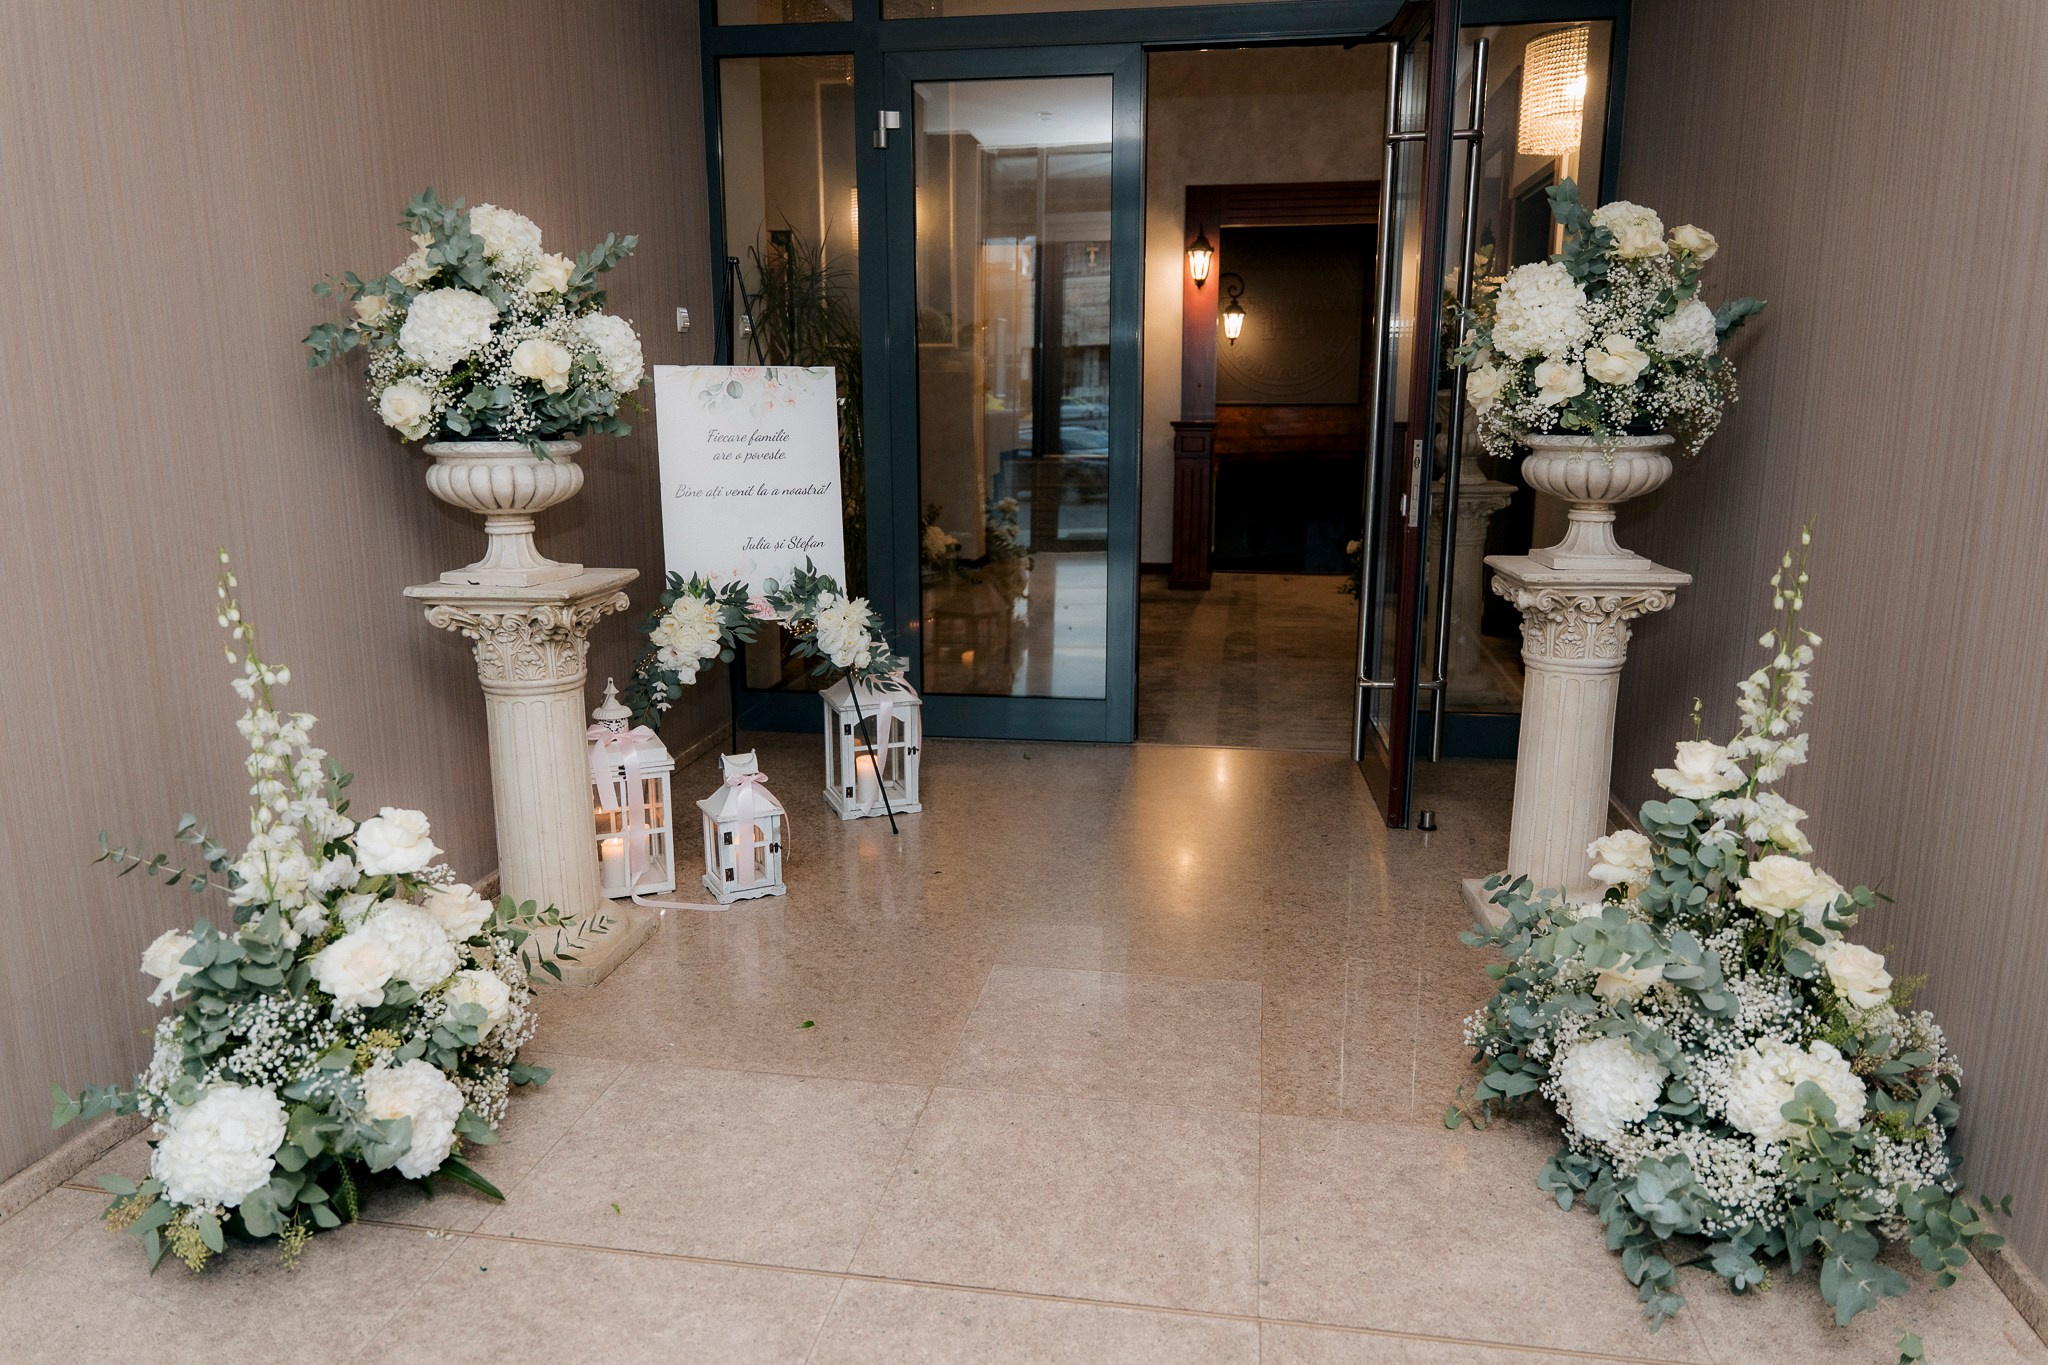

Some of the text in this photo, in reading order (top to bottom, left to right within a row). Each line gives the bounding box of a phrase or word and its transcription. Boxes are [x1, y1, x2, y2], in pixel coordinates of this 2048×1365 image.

[707, 429, 790, 446] Fiecare familie
[713, 452, 732, 460] are
[743, 449, 786, 463] poveste.
[675, 484, 703, 498] Bine
[726, 485, 754, 496] venit
[757, 483, 769, 496] la
[771, 488, 780, 496] a
[782, 482, 831, 495] noastră!
[742, 537, 771, 551] Julia
[787, 535, 825, 552] Stefan
